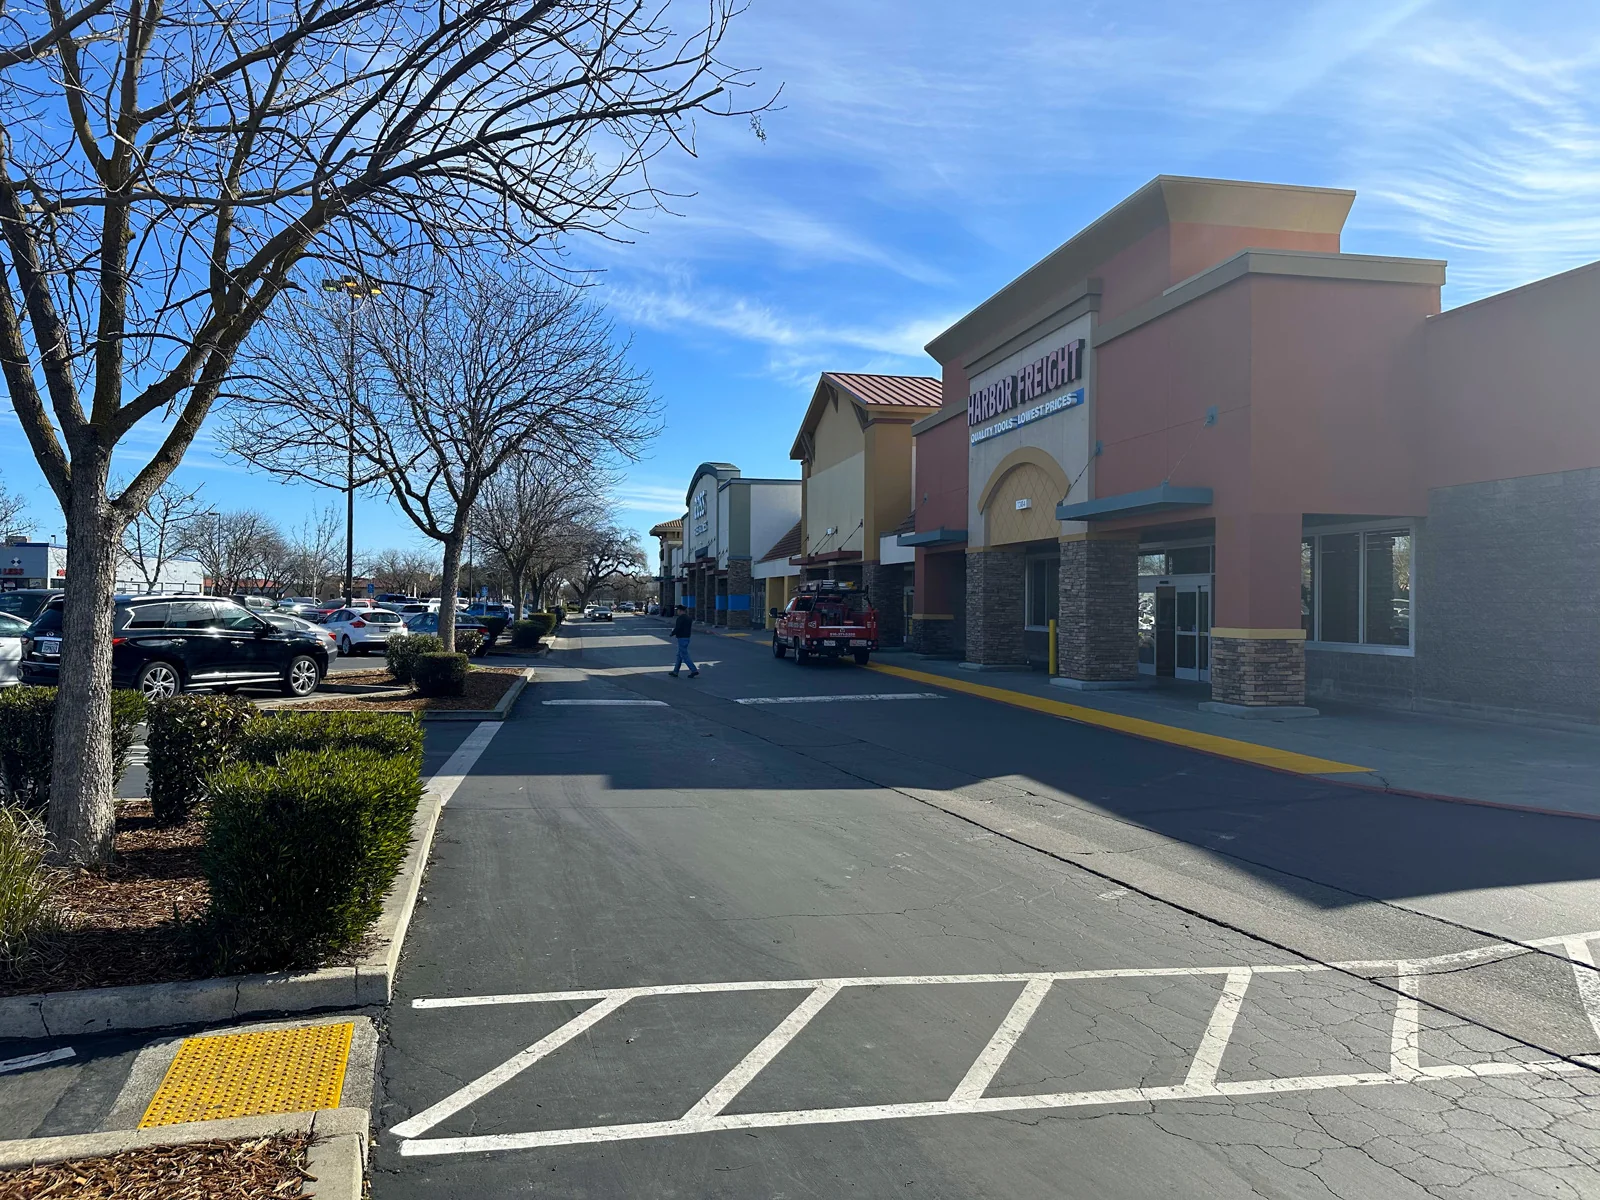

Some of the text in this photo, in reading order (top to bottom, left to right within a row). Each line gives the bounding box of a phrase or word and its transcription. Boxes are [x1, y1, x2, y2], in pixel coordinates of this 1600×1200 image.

[967, 339, 1083, 426] HARBOR FREIGHT
[970, 393, 1073, 443] QUALITY TOOLS LOWEST PRICES
